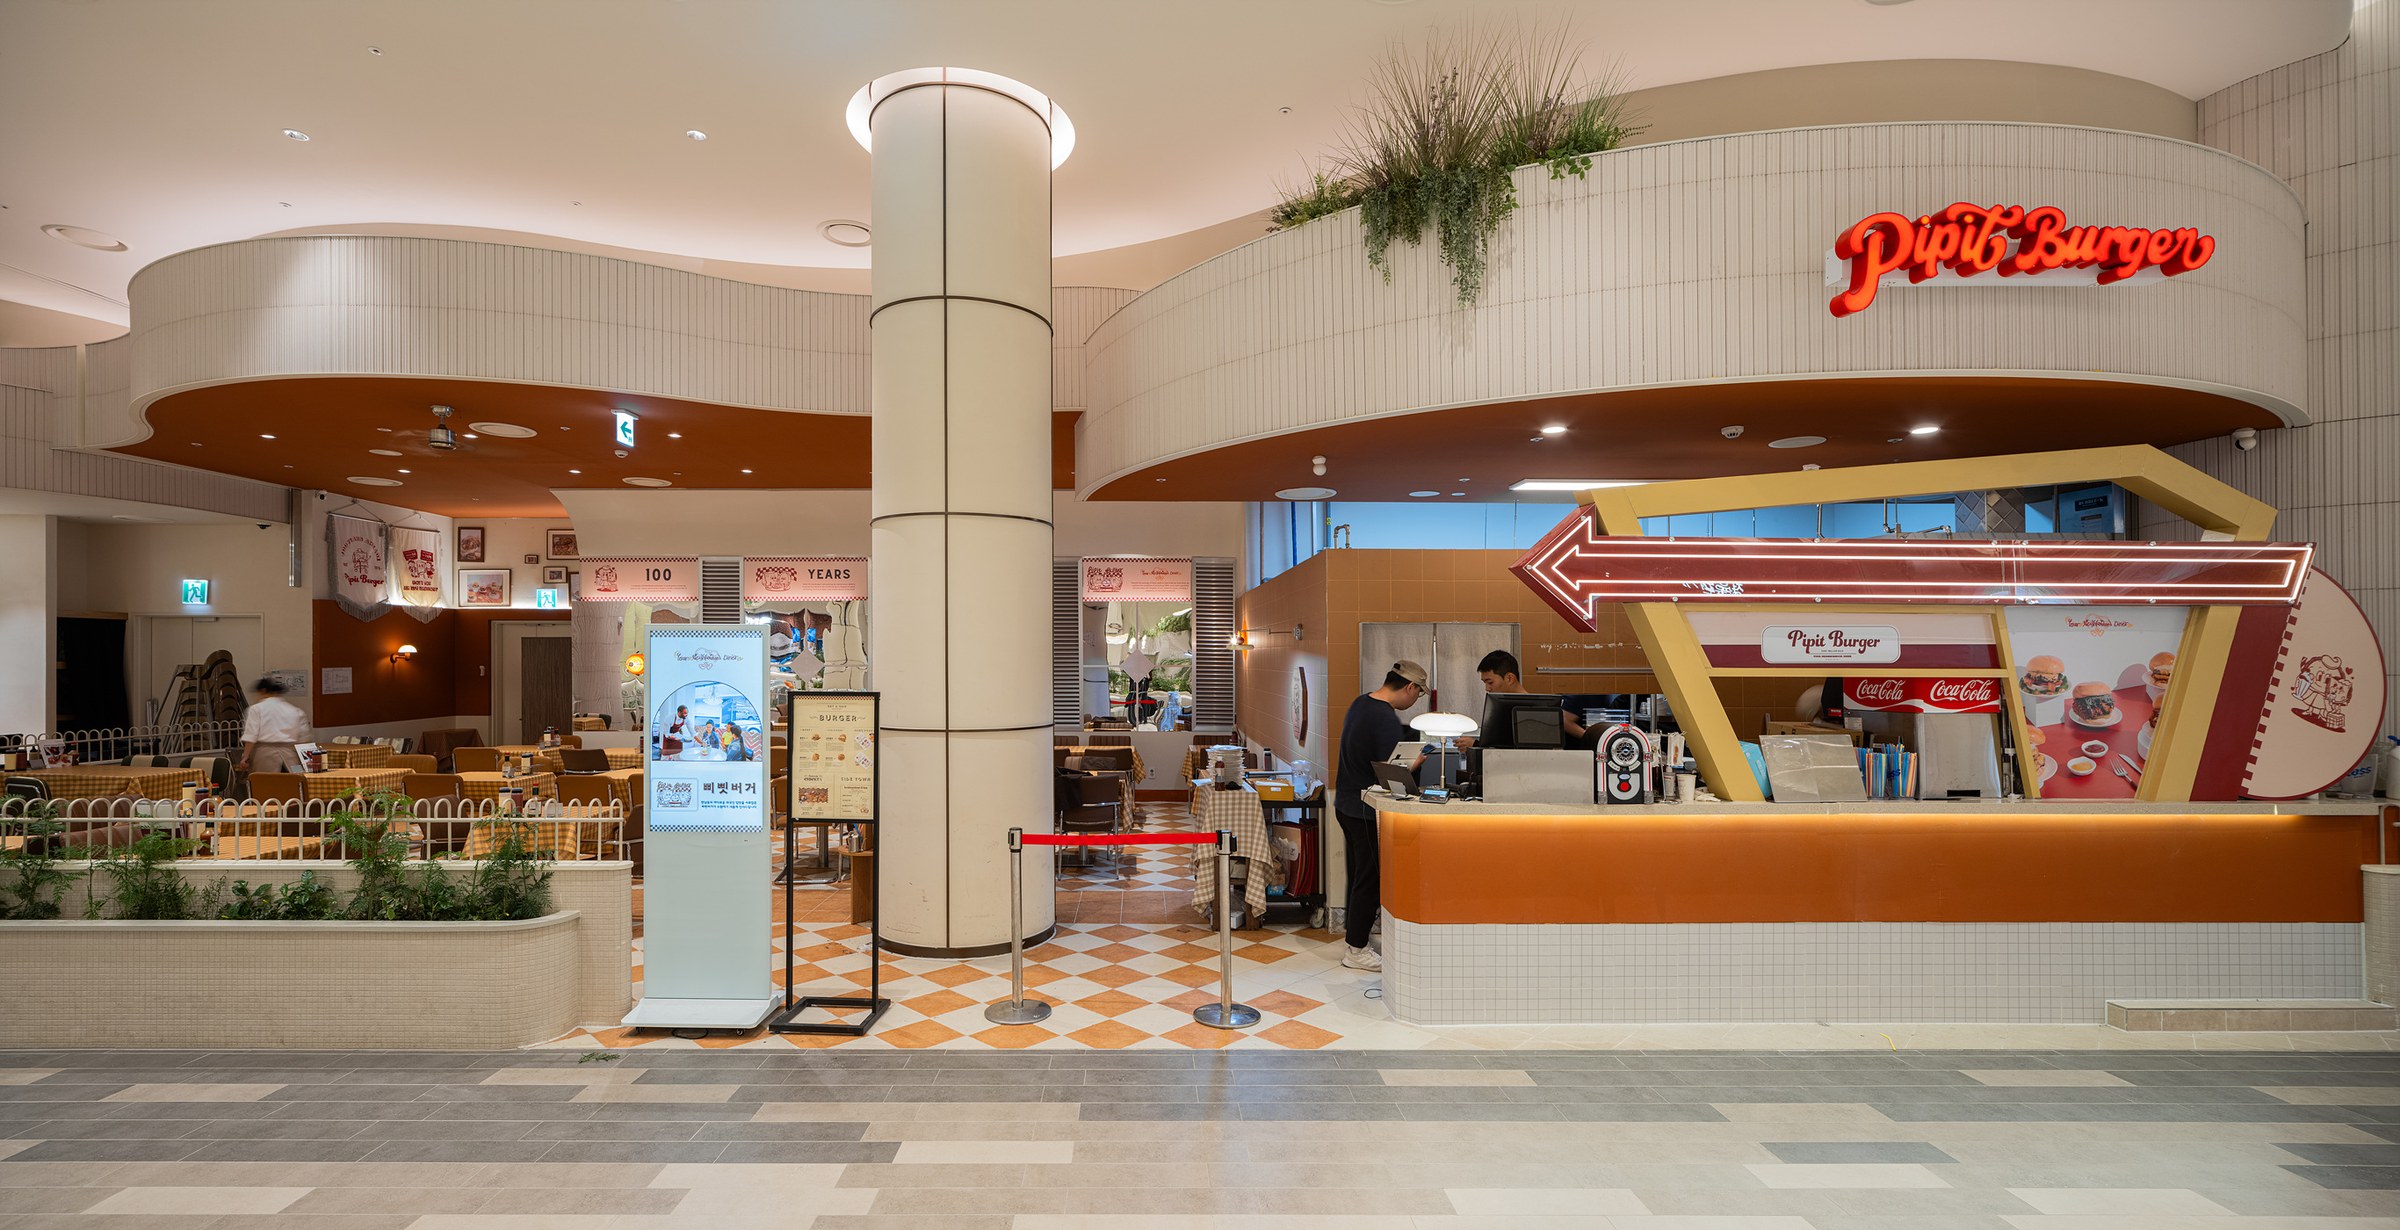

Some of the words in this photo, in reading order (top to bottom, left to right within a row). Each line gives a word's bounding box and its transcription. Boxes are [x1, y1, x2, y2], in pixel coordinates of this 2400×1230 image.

[1838, 202, 2024, 316] Pipit
[2003, 206, 2215, 283] Burger
[645, 568, 672, 581] 100
[808, 569, 851, 580] YEARS
[1787, 630, 1826, 654] Pipit
[1828, 630, 1880, 654] Burger
[1856, 679, 1906, 700] Coca-Cola
[1929, 679, 1994, 702] Coca-Cola
[819, 714, 857, 722] BURGER
